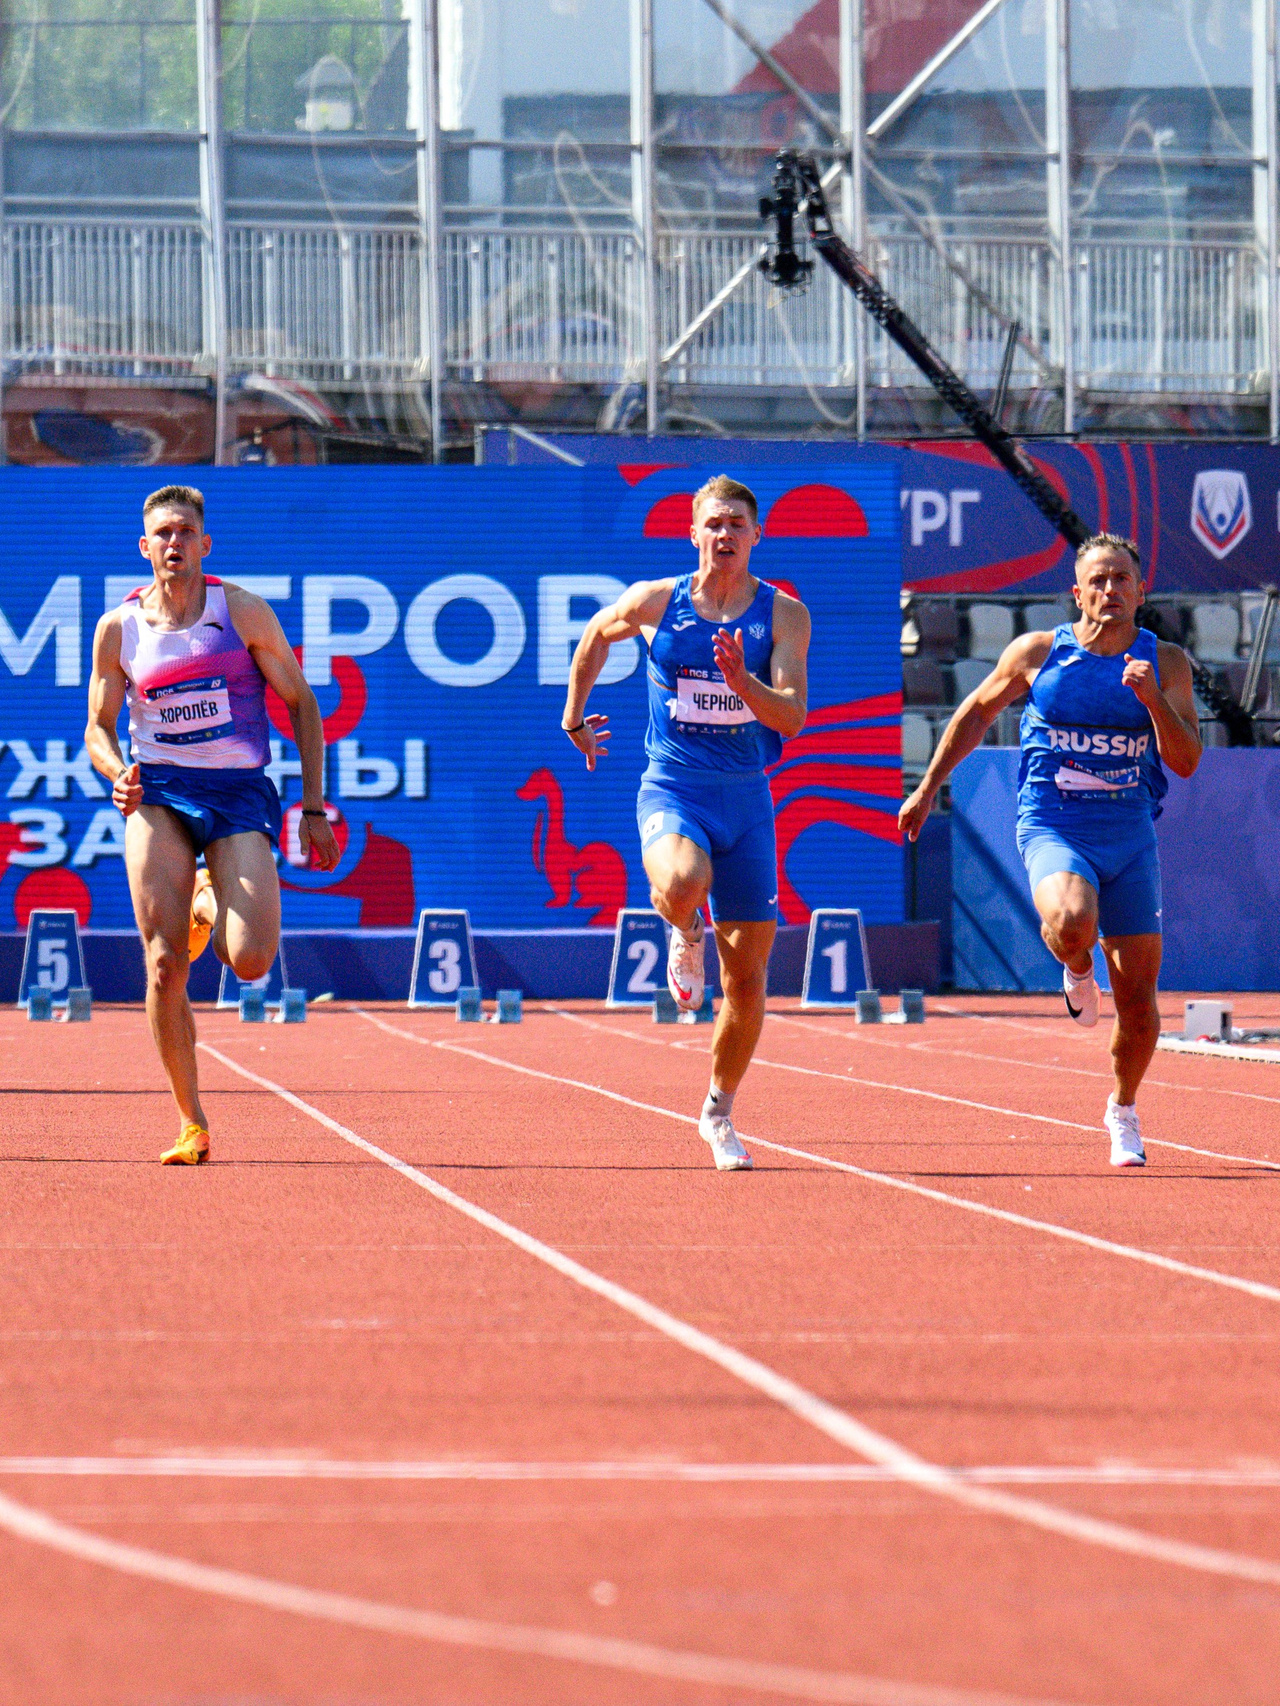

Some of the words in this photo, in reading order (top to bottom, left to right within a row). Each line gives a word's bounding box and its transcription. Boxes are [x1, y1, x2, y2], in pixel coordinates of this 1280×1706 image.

[688, 669, 709, 679] ПСБ
[1046, 729, 1150, 758] RUSSIA
[37, 939, 70, 992] 5
[428, 939, 461, 994] 3
[627, 940, 659, 993] 2
[821, 940, 847, 993] 1
